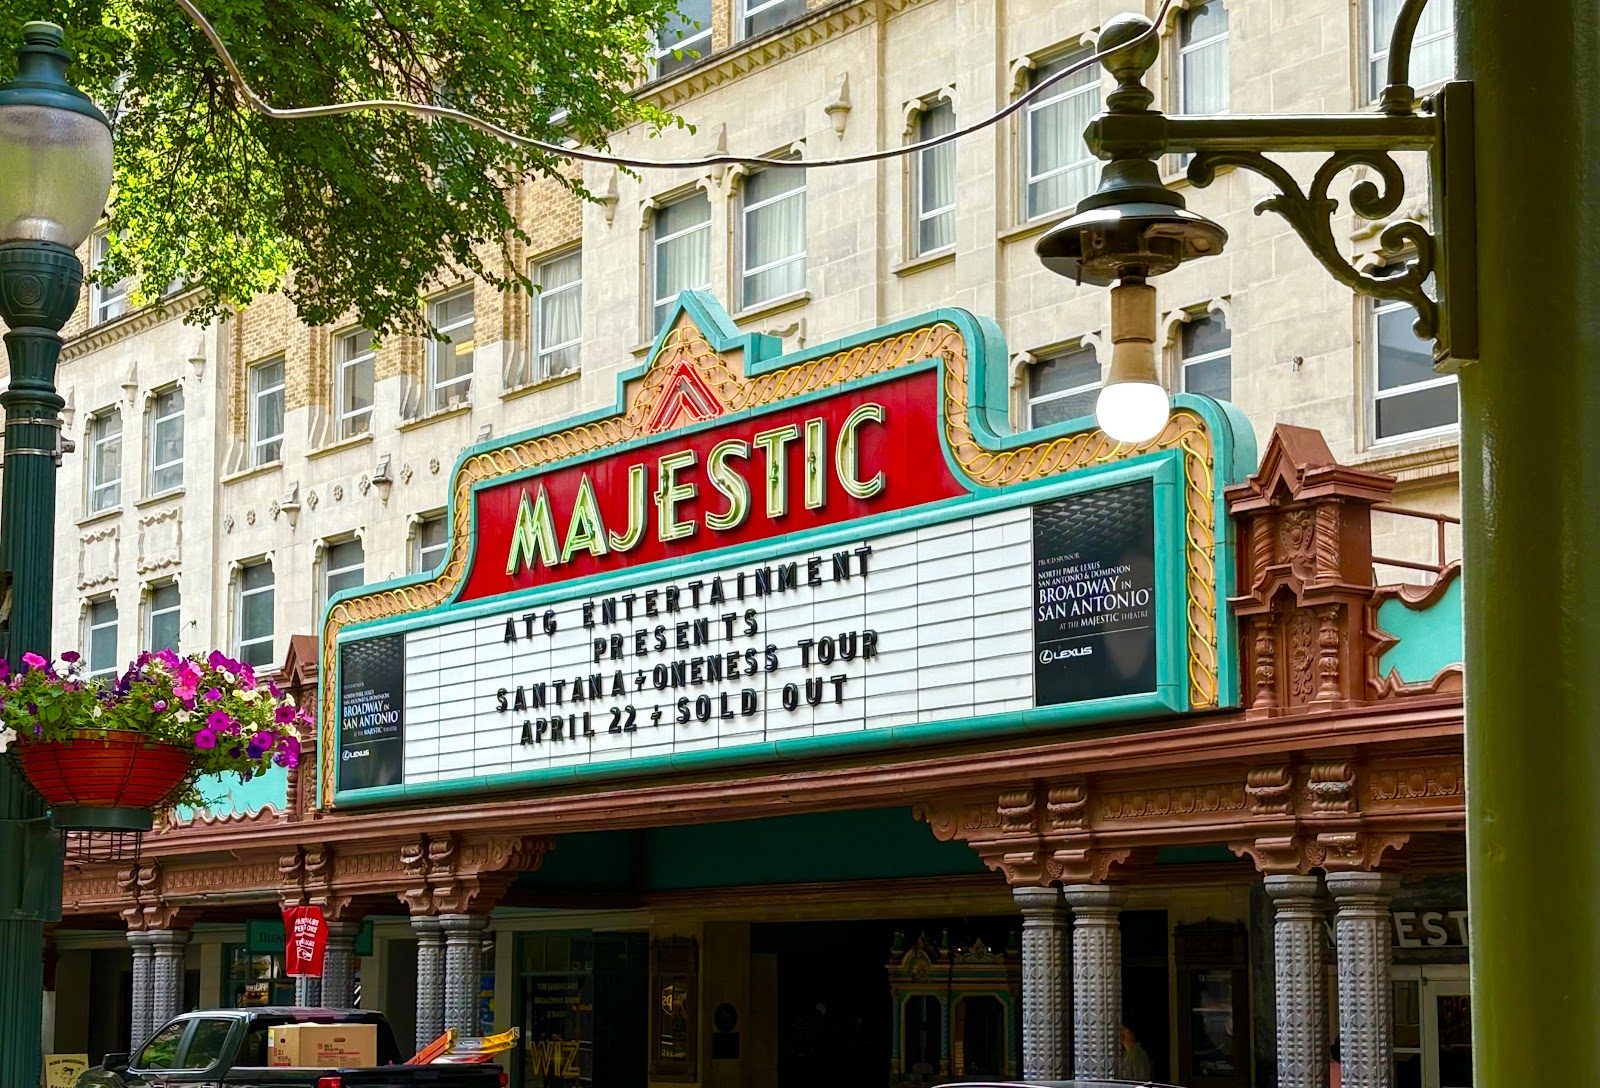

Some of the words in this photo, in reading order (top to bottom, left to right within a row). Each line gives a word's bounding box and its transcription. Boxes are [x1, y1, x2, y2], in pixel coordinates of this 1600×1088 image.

[505, 402, 886, 575] MAJESTIC
[1038, 568, 1062, 580] NORTH
[1063, 565, 1080, 576] PARK
[1080, 561, 1101, 572] LEXUS
[1038, 579, 1050, 588] SAN
[1051, 573, 1083, 585] ANTONIO
[1091, 564, 1131, 578] DOMINION
[504, 609, 557, 644] ATG
[583, 546, 872, 629] ENTERTAINMENT
[1039, 575, 1119, 604] BROADWAY
[1121, 580, 1132, 590] IN
[1039, 602, 1067, 622] SAN
[1070, 588, 1149, 617] ANTONIO
[1080, 613, 1120, 627] MAJESTIC
[594, 608, 758, 663] PRESENTS
[1053, 646, 1093, 659] LEXUS
[496, 669, 626, 713] SANTANA
[653, 644, 779, 690] ONENESS
[798, 629, 878, 668] TOUR
[342, 717, 358, 730] SAN
[359, 710, 399, 728] ANTONIO
[343, 700, 384, 717] BROADWAY
[520, 711, 595, 745] APRIL
[609, 705, 637, 734] 22
[676, 688, 758, 724] SOLD
[782, 674, 847, 711] OUT
[349, 749, 370, 758] LEXUS
[529, 1040, 580, 1077] WIZ
